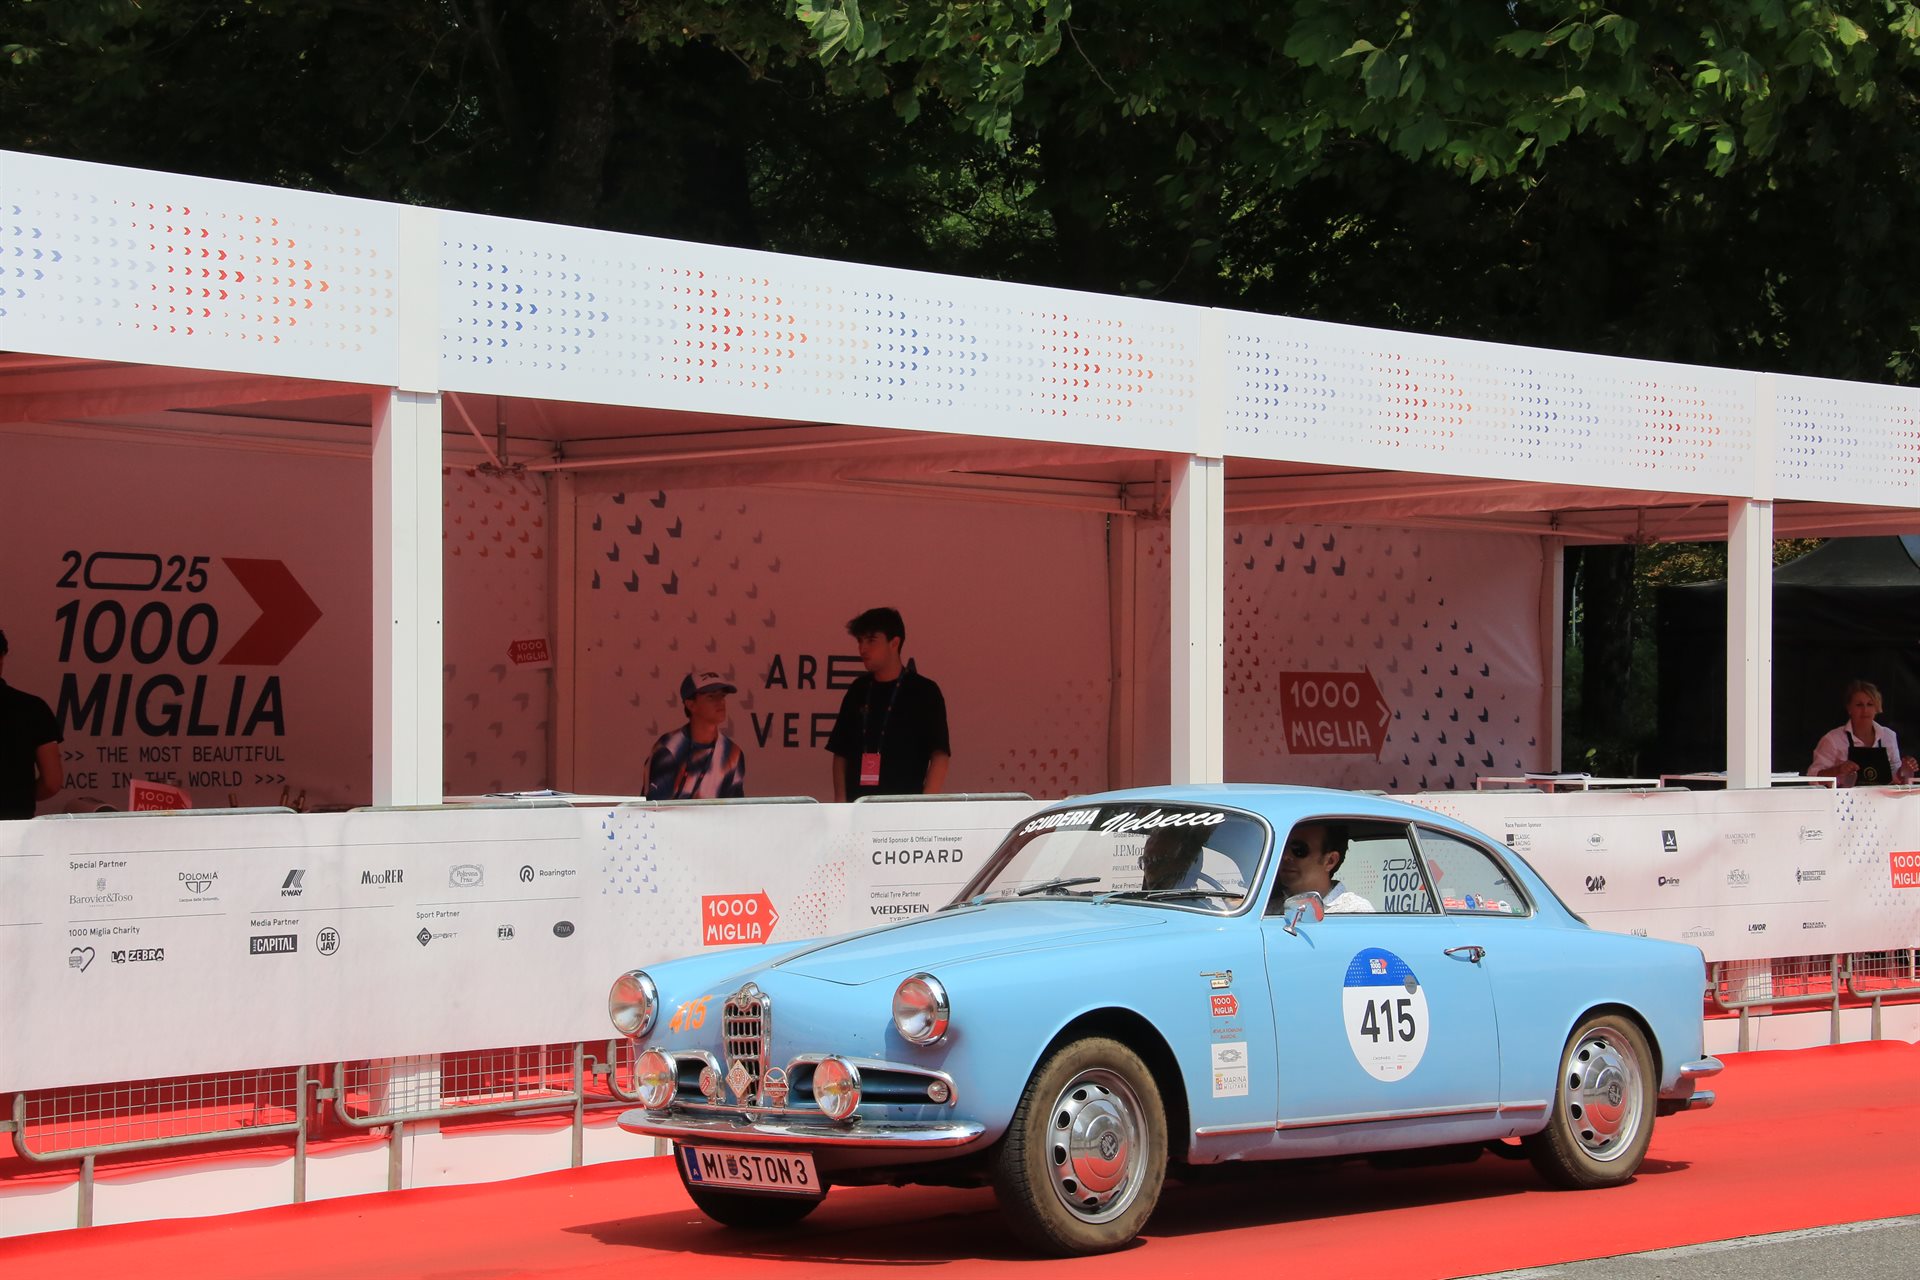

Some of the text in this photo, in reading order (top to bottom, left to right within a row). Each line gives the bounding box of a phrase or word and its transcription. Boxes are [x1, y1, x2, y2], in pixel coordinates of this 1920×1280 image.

[55, 550, 210, 593] 2025
[55, 598, 219, 665] 1000
[516, 641, 543, 651] 1000
[516, 651, 548, 662] MIGLIA
[1290, 681, 1360, 708] 1000
[56, 673, 286, 737] MIGLIA
[1291, 720, 1372, 748] MIGLIA
[96, 745, 285, 762] THE MOST BEAUTIFUL
[111, 771, 133, 788] IN
[188, 771, 242, 787] WORLD
[139, 791, 175, 803] 1000
[1018, 809, 1101, 837] SCUDERIA
[889, 837, 909, 845] Sponsor
[934, 835, 963, 843] Timekeeper
[1112, 844, 1145, 857] J.P.Mor
[871, 849, 963, 865] CHOPARD
[69, 859, 127, 871] Special Partner
[178, 872, 219, 881] DOLOMIA
[539, 868, 577, 878] Roarington
[1893, 871, 1920, 886] MIGLI
[1383, 872, 1420, 893] 1000
[68, 893, 133, 905] Barovier&Toso
[871, 890, 921, 899] Official Tyre Partner
[708, 898, 758, 917] 1000
[870, 903, 930, 915] VREDESTEIN
[416, 910, 460, 920] Sport Partner
[250, 918, 299, 927] Media Partner
[1748, 923, 1767, 932] LAVOR
[68, 926, 140, 937] 1000 Miglia Charity
[556, 925, 571, 933] FIVA
[707, 923, 762, 942] MIGLIA
[320, 932, 336, 942] DEE
[256, 936, 295, 952] CAPITAL
[320, 941, 336, 951] JAY
[111, 948, 165, 963] LA ZEBRA
[1213, 997, 1231, 1005] 1000
[668, 994, 713, 1033] 415
[1360, 998, 1416, 1043] 415
[1223, 1076, 1247, 1084] MARINA
[692, 1153, 808, 1186] A MI STON 3
